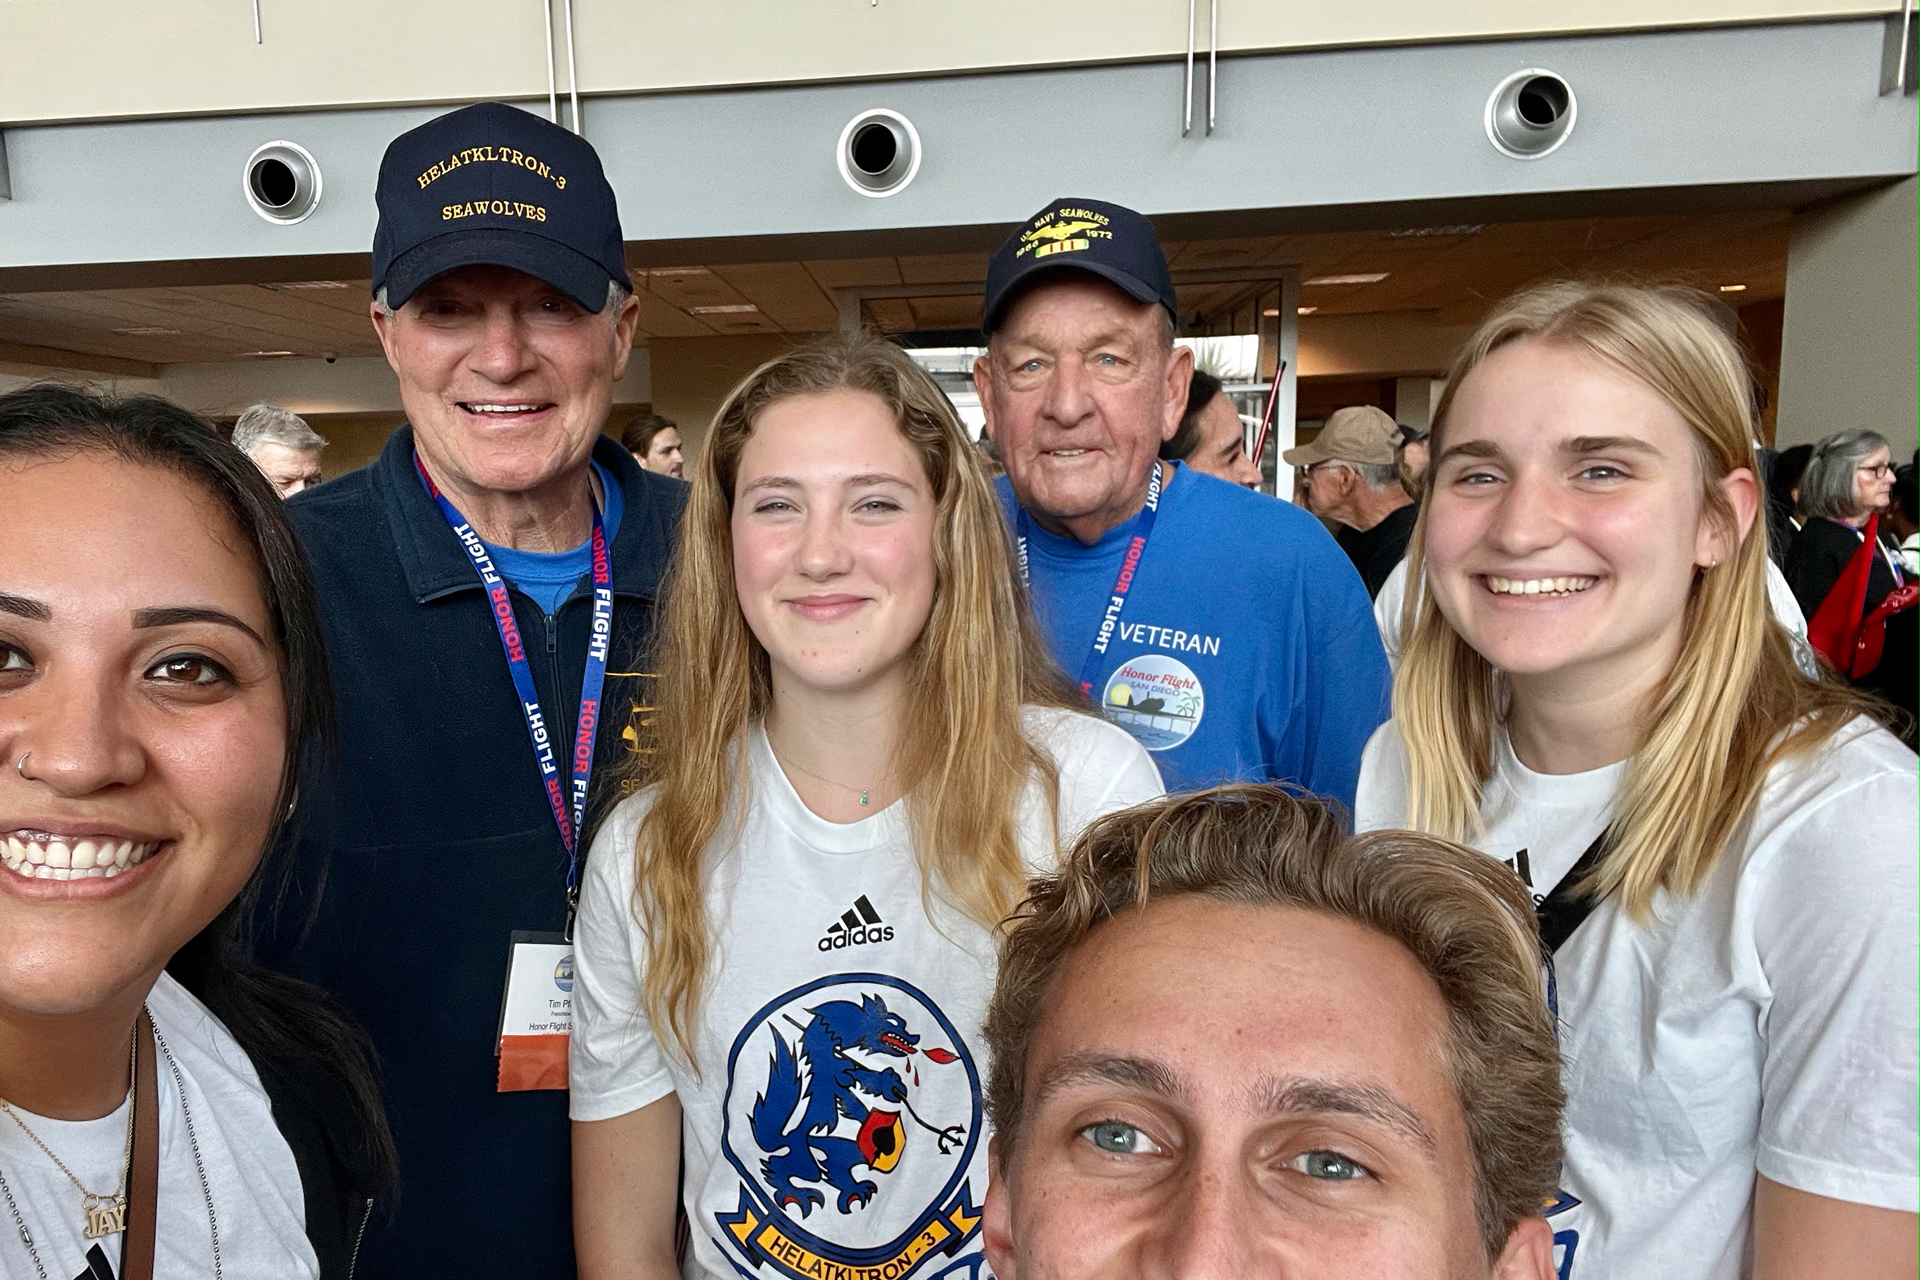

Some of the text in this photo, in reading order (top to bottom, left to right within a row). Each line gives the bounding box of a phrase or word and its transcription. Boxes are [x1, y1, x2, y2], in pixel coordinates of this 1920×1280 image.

[417, 146, 567, 190] HELATKLTRON-3
[442, 200, 546, 222] SEAWOLVES
[1034, 212, 1055, 229] NAVY
[1059, 208, 1110, 226] SEAWOLVES
[1085, 229, 1113, 240] 1972
[1146, 462, 1163, 512] FLIGHT
[1017, 537, 1030, 587] LIGHT
[454, 523, 524, 662] HONOR FLIGHT
[590, 526, 611, 662] HONOR FLIGHT
[1094, 535, 1146, 654] HONOR FLIGHT
[1119, 622, 1220, 656] VETERAN
[1120, 667, 1196, 690] Honor Flight
[1129, 681, 1181, 697] SAN DIEGO
[525, 702, 556, 774] FLIGHT
[574, 700, 598, 773] HONOR
[818, 925, 895, 952] adidas
[549, 999, 561, 1008] Tim
[529, 1022, 548, 1031] Honor
[549, 1022, 567, 1032] Flight
[84, 1205, 126, 1239] JAY
